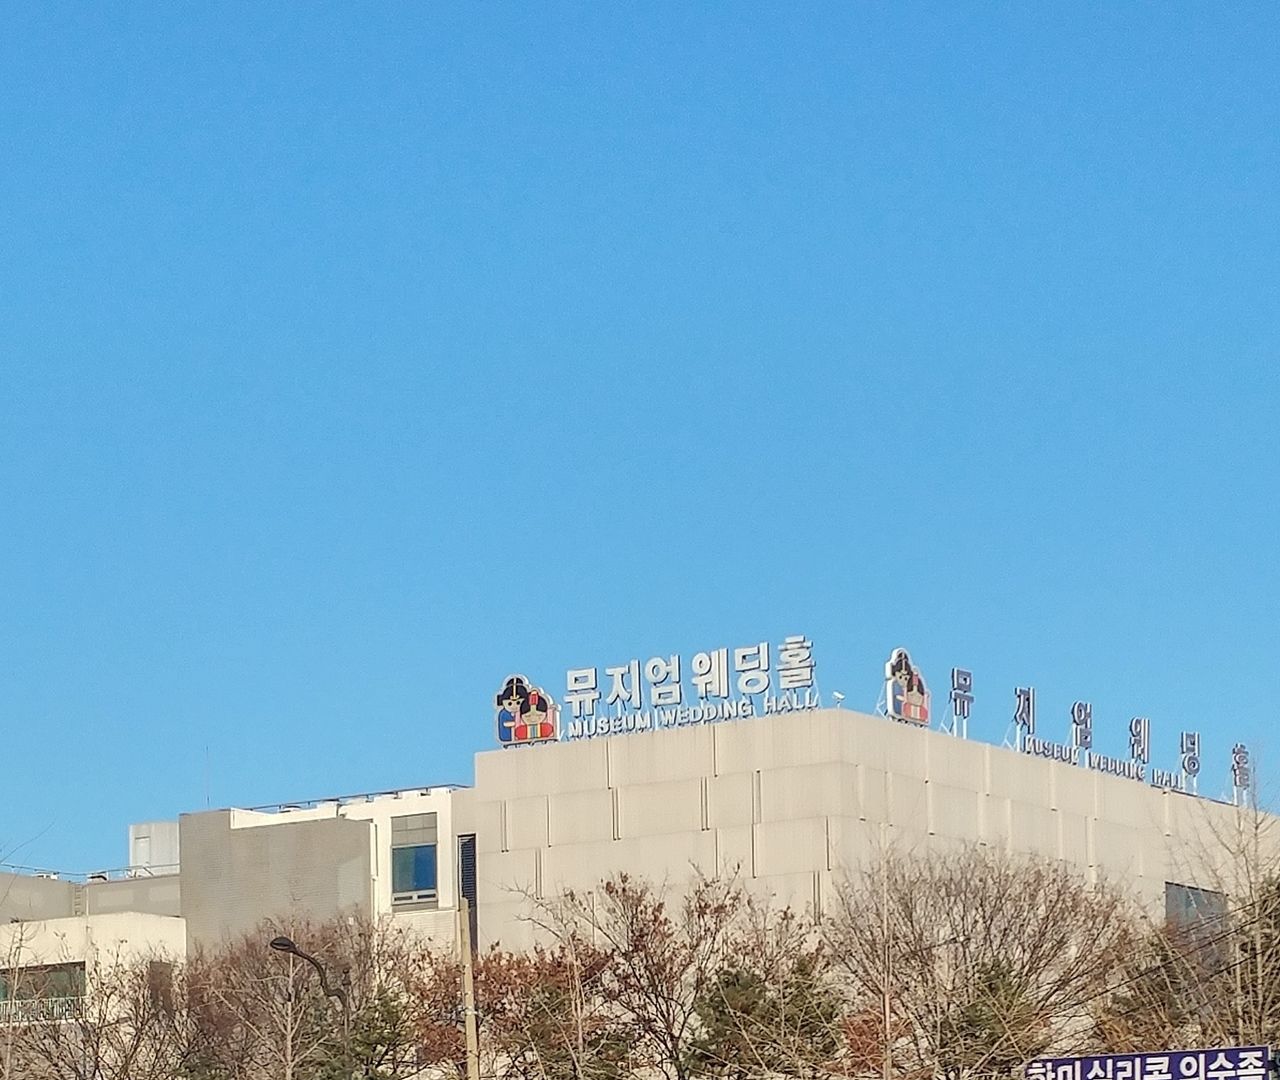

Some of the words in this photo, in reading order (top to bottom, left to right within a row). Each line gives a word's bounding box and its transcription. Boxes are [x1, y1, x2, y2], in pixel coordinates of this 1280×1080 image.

[564, 655, 681, 718] 뮤지엄
[691, 635, 816, 698] 웨딩홀
[568, 713, 653, 740] MUSEUM
[661, 699, 754, 725] WEDDING
[764, 691, 819, 713] HALL
